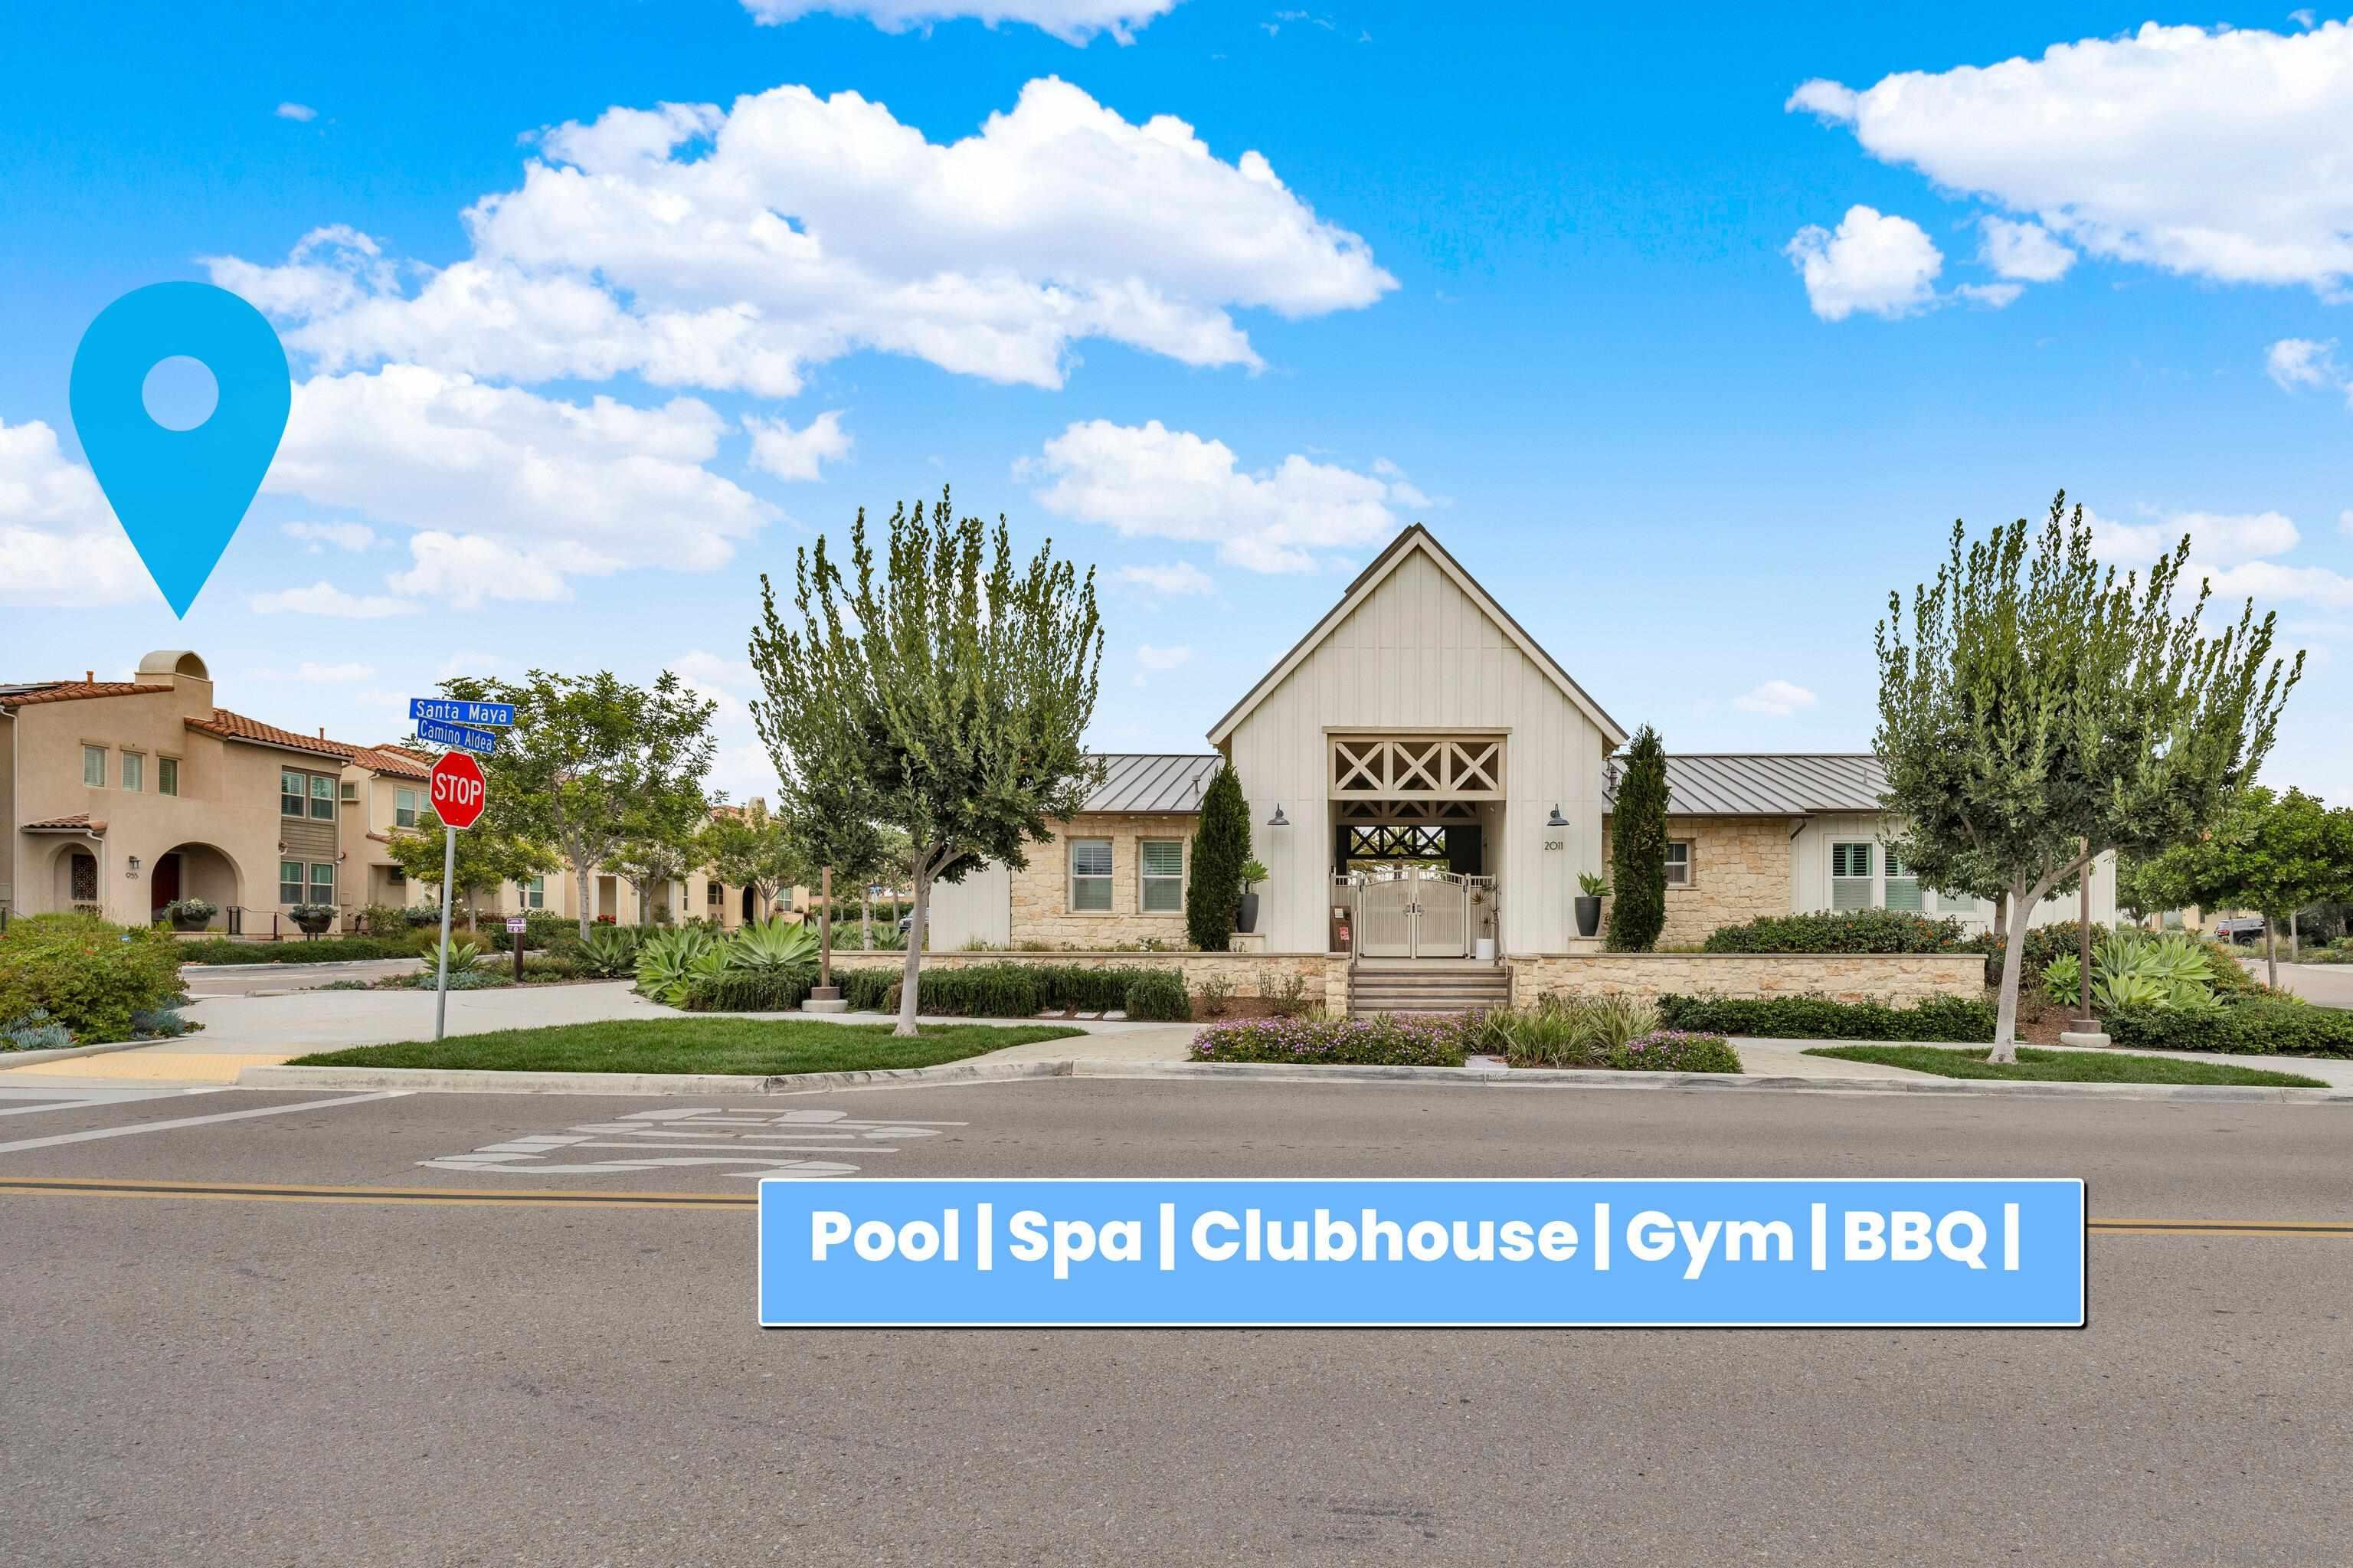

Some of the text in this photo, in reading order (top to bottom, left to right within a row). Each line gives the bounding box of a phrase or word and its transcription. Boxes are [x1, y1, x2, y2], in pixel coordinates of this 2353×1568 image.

[417, 700, 506, 723] Santa Maya
[421, 720, 492, 751] Camino Aldea
[434, 772, 482, 806] STOP
[1544, 841, 1563, 850] 2011
[415, 1108, 969, 1179] STOP
